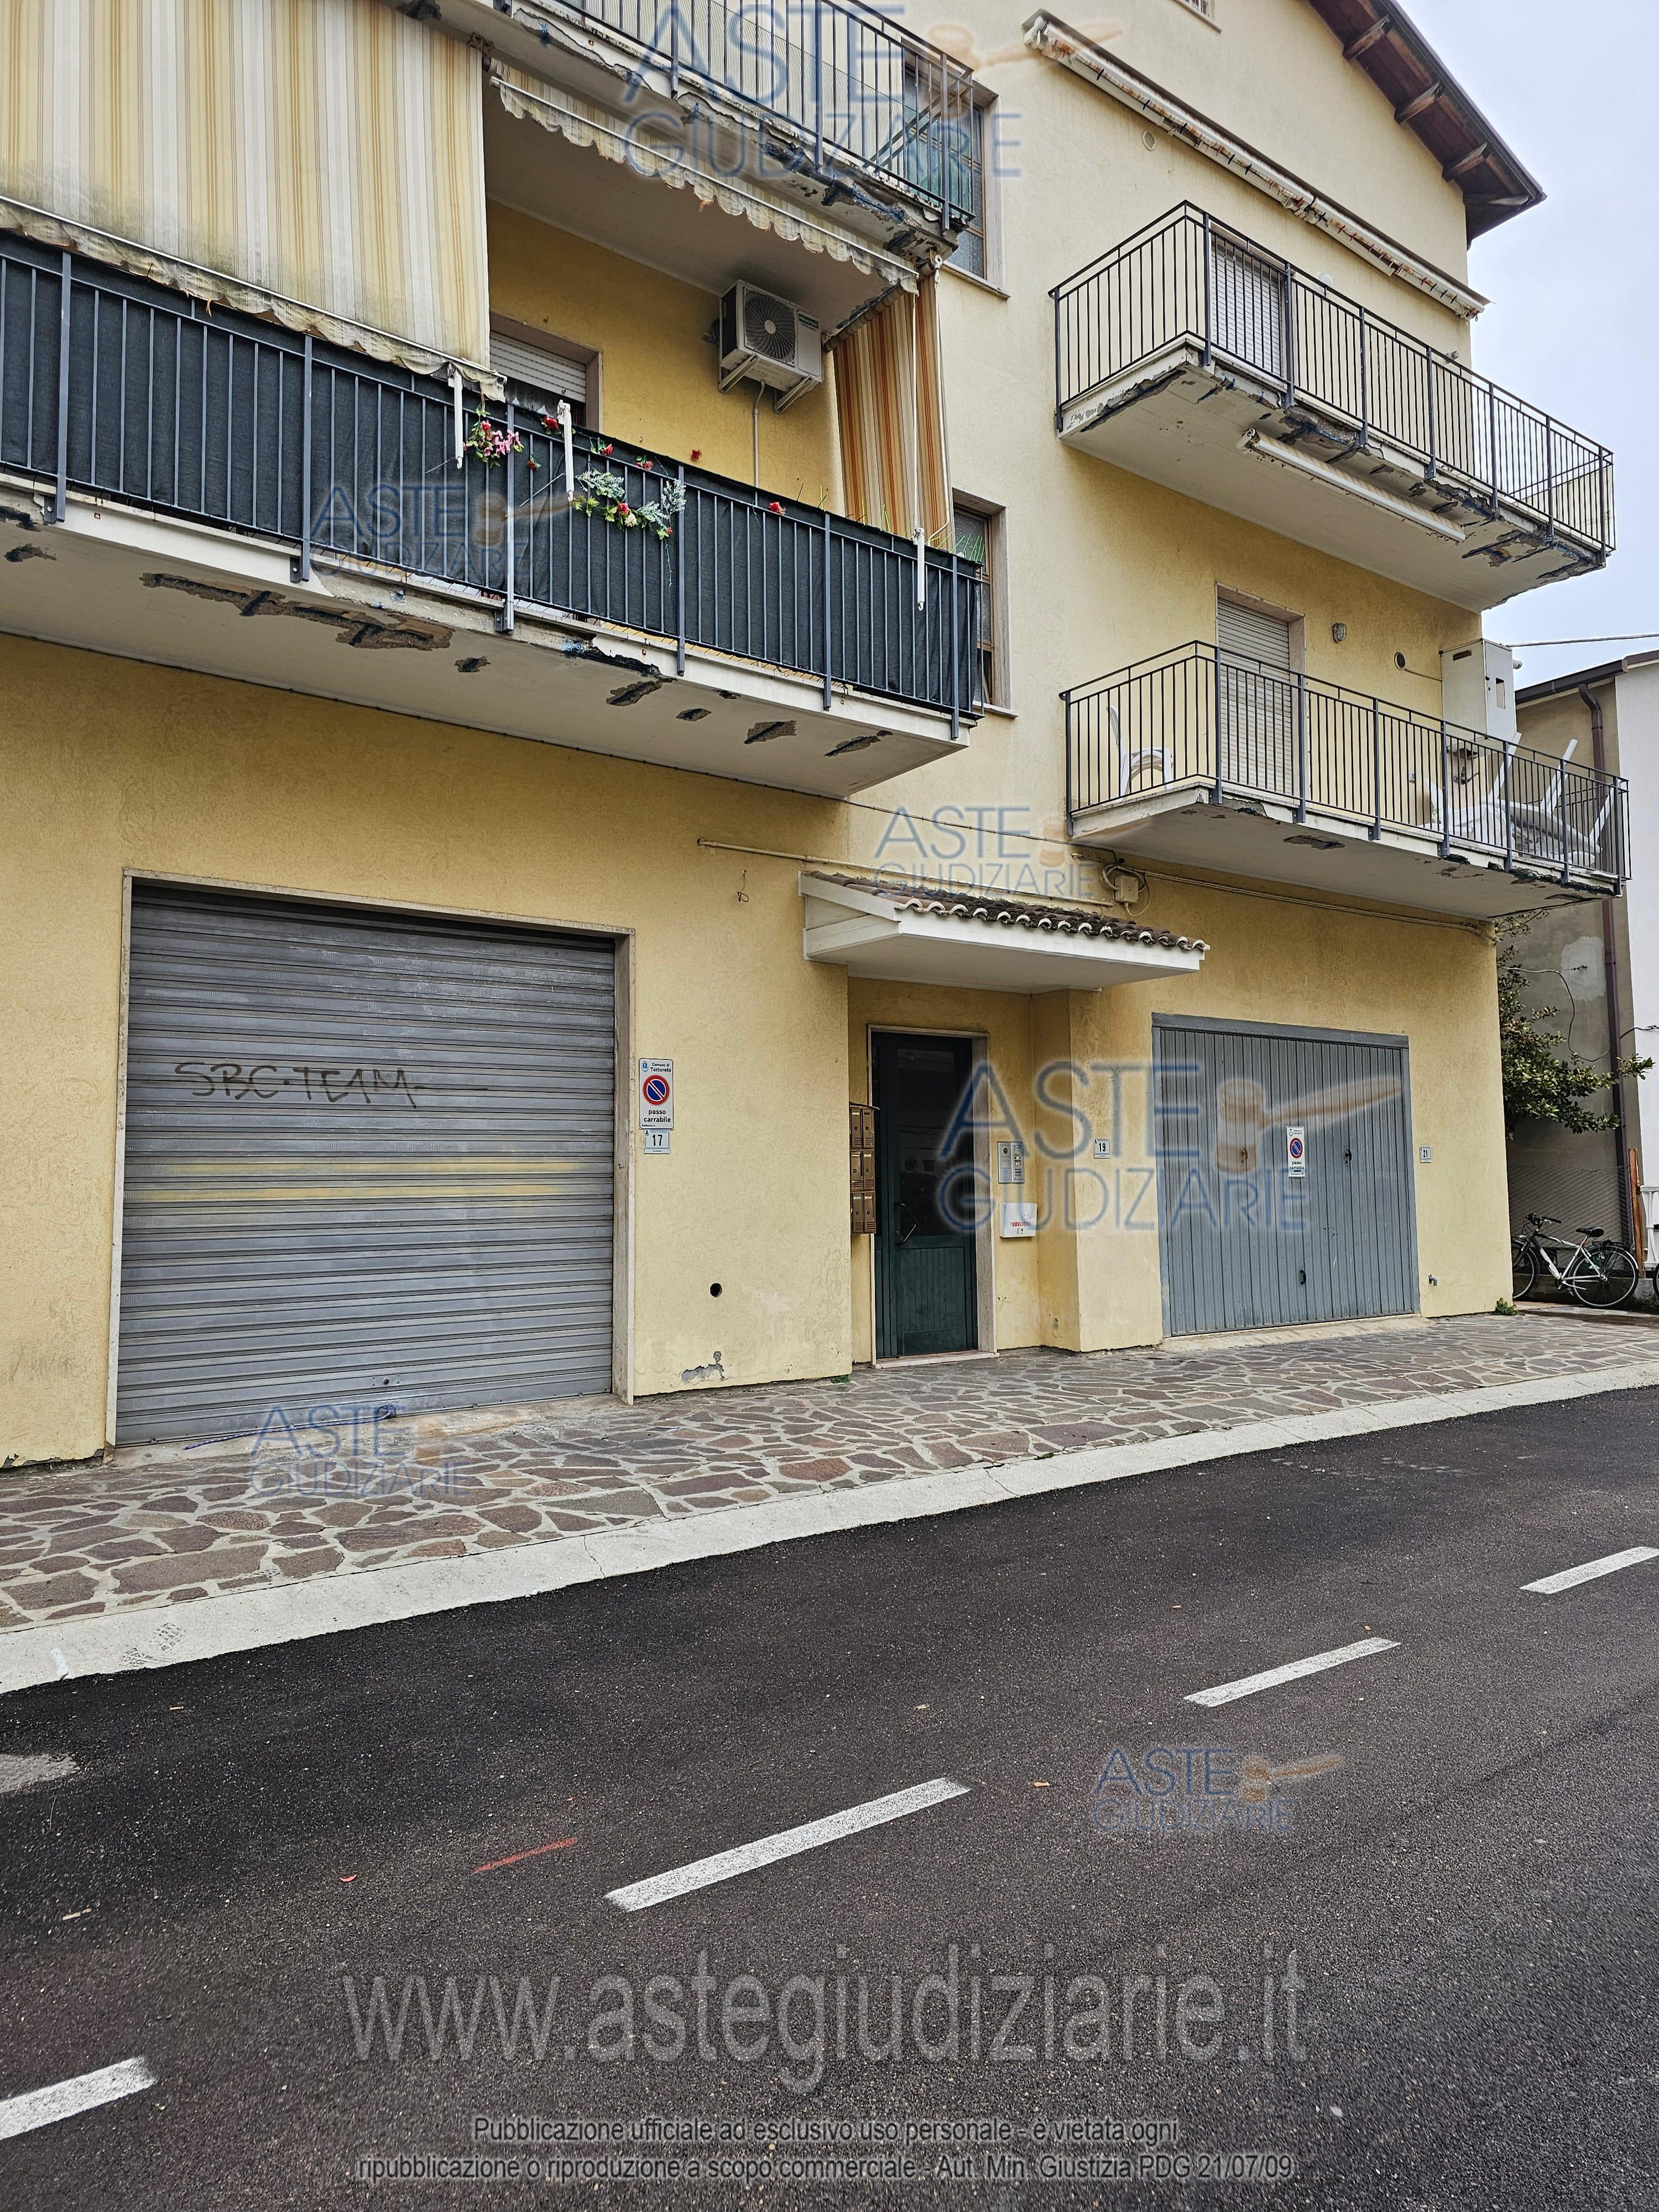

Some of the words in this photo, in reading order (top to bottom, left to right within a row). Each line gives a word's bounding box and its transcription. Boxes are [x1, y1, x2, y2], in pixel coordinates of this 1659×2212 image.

[653, 1134, 662, 1146] 17
[1099, 1142, 1106, 1152] 19
[1423, 1149, 1428, 1157] 21
